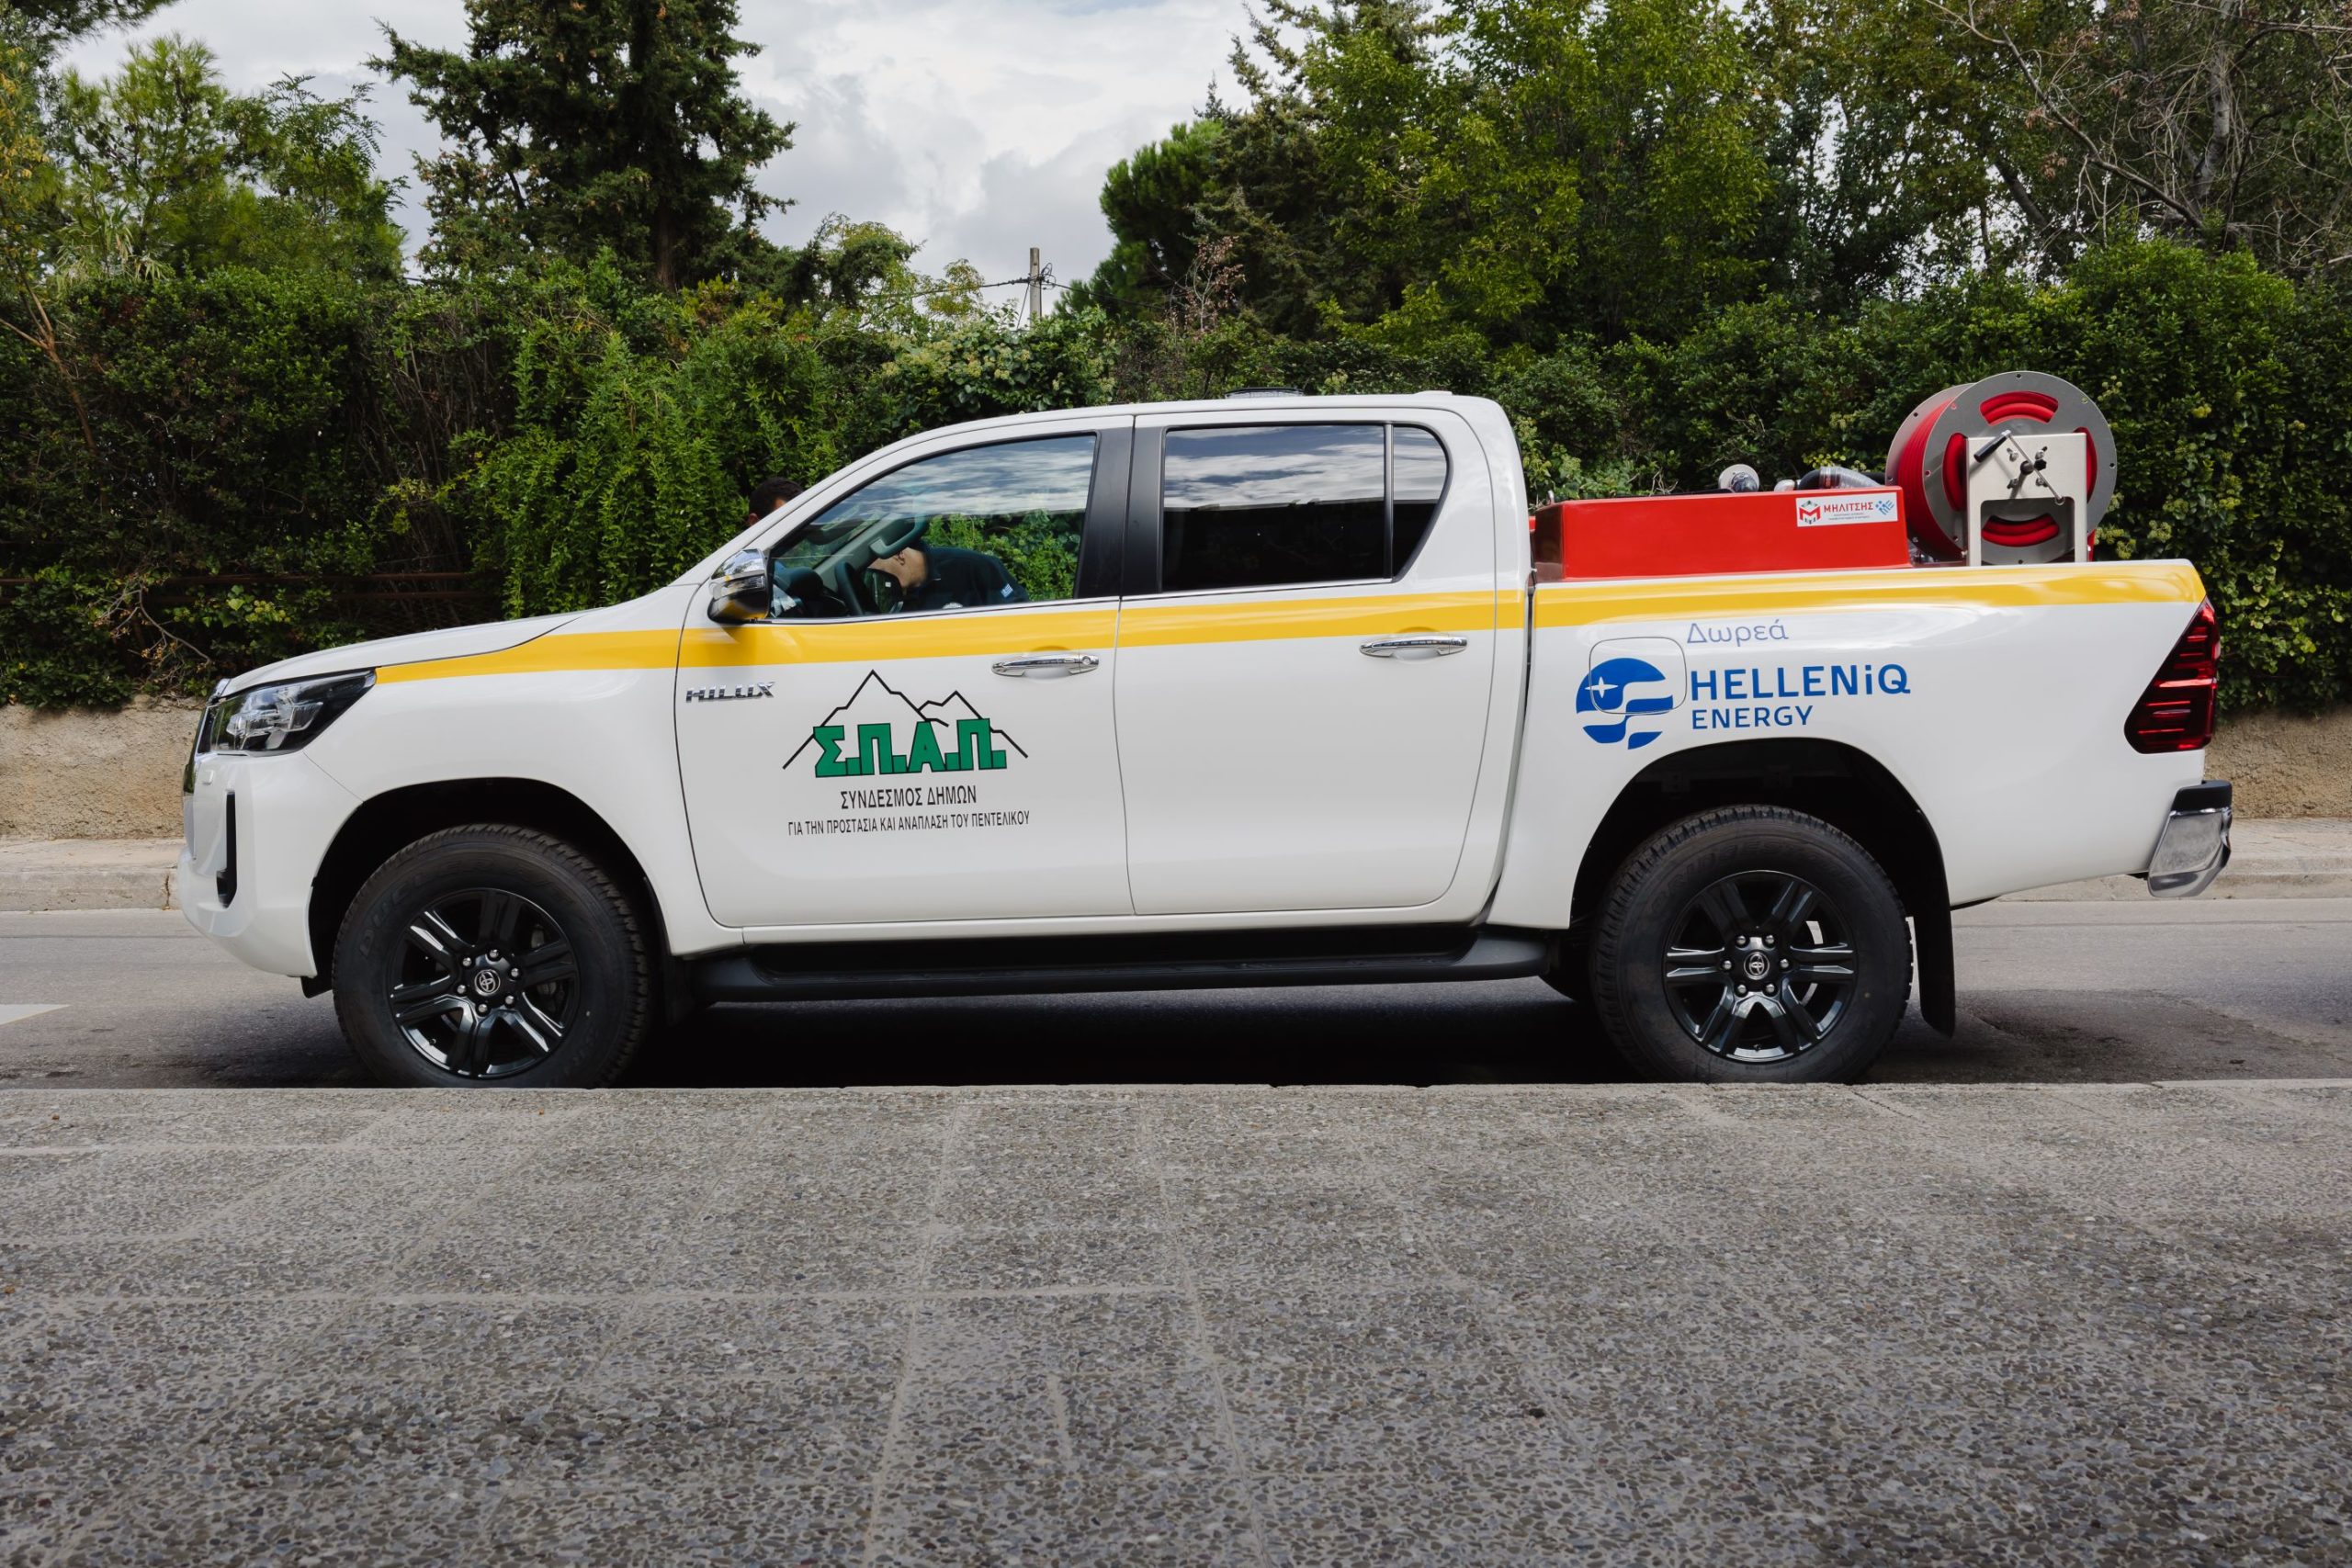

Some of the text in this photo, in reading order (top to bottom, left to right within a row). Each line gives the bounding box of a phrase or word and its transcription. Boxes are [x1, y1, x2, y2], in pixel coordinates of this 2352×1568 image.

[1824, 502, 1873, 513] ΜΗΛΙΤΣΗΣ
[1686, 619, 1789, 648] Δωρεά
[686, 681, 775, 703] HILUX
[1690, 663, 1911, 701] HELLENiQ
[1691, 705, 1813, 730] ENERGY
[813, 717, 1007, 778] Σ.Π.Α.Π.
[840, 784, 977, 810] ΣΥΝΔΕΣΜΟΣ ΔΗΜΩΝ
[787, 810, 1030, 836] ΓΙΑ ΤΗΝ ΠΡΟΣΤΑΣΙΑ ΚΑΙ ΑΝΑΠΛΑΣΗ ΤΟΥ ΠΕΝΤΕΛΙΚΟΥ
